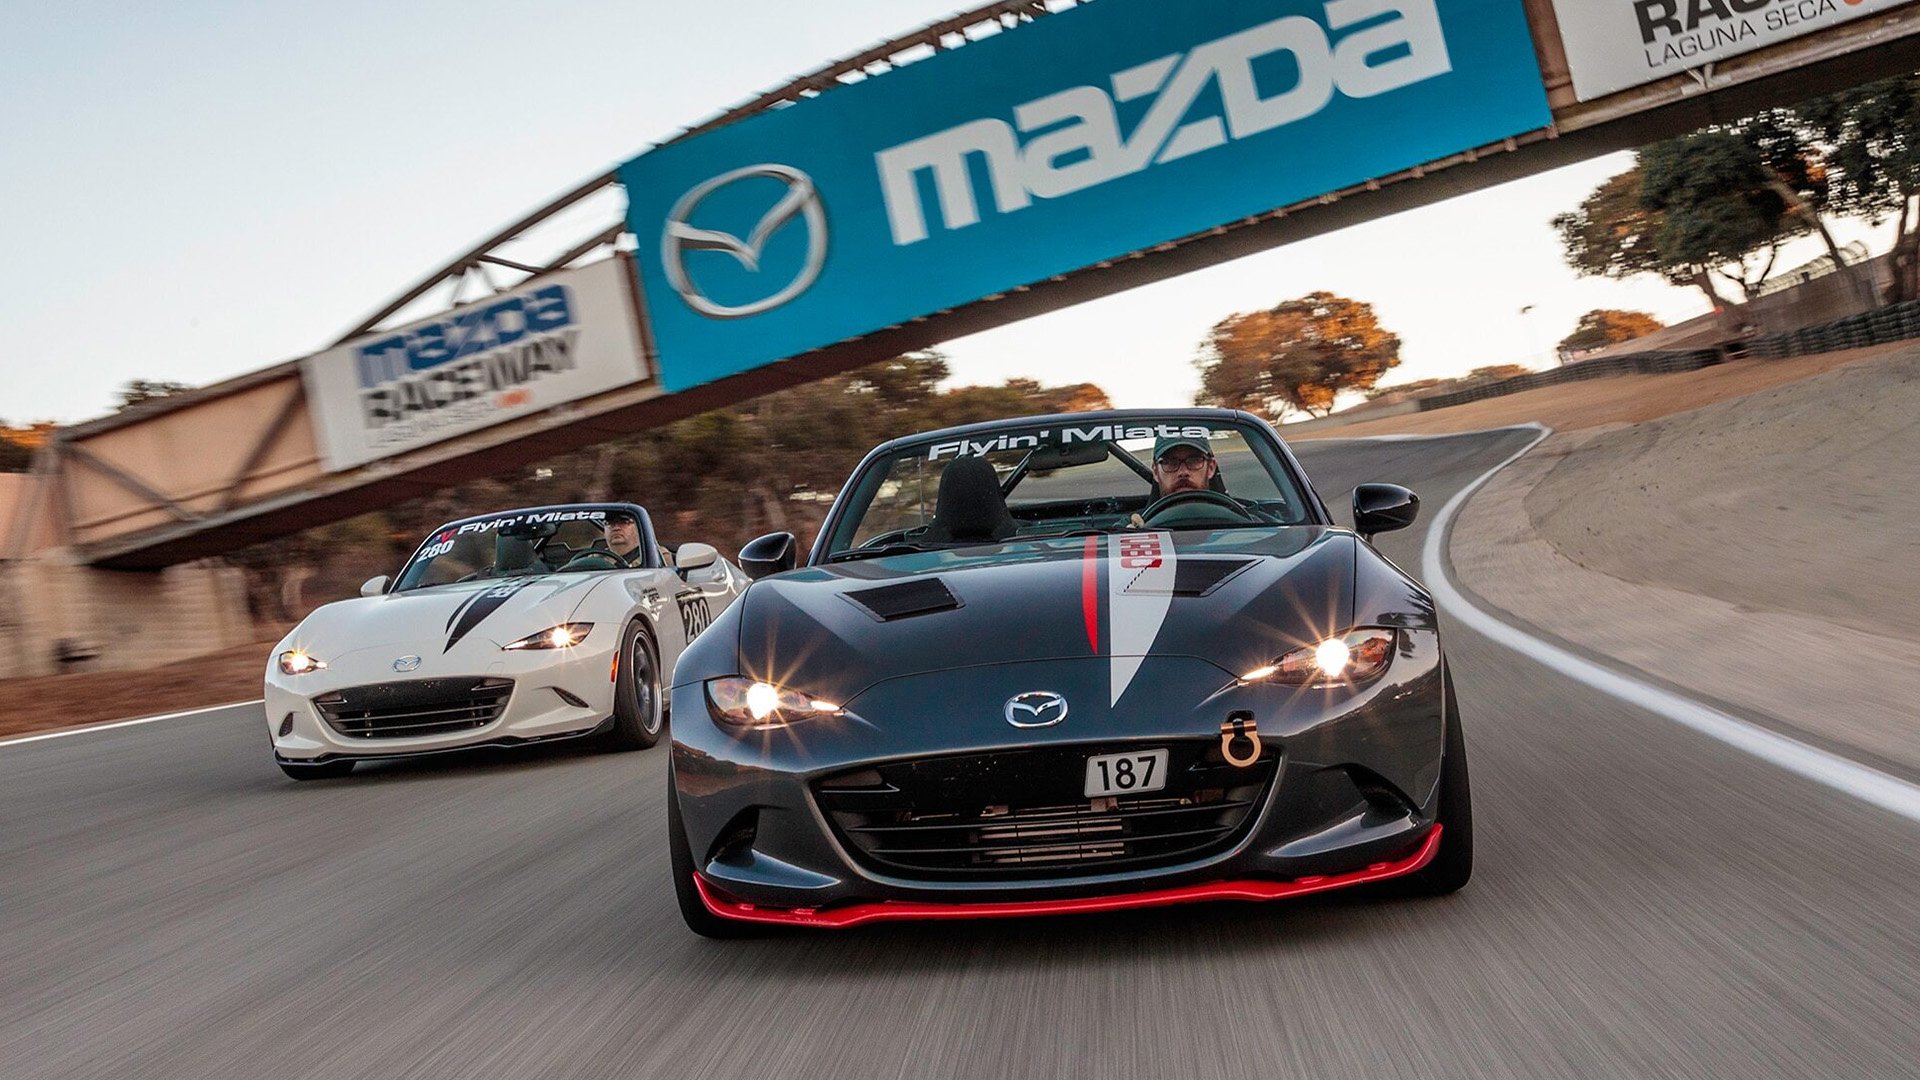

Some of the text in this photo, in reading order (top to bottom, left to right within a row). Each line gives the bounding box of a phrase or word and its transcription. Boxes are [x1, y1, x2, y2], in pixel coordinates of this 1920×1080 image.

[1643, 0, 1837, 68] LAGUNA SECA
[928, 424, 1211, 461] Flyin' Miata
[457, 511, 606, 536] Flyin' Miata
[416, 539, 455, 563] 280
[683, 598, 712, 644] 280
[1096, 755, 1157, 792] 187
